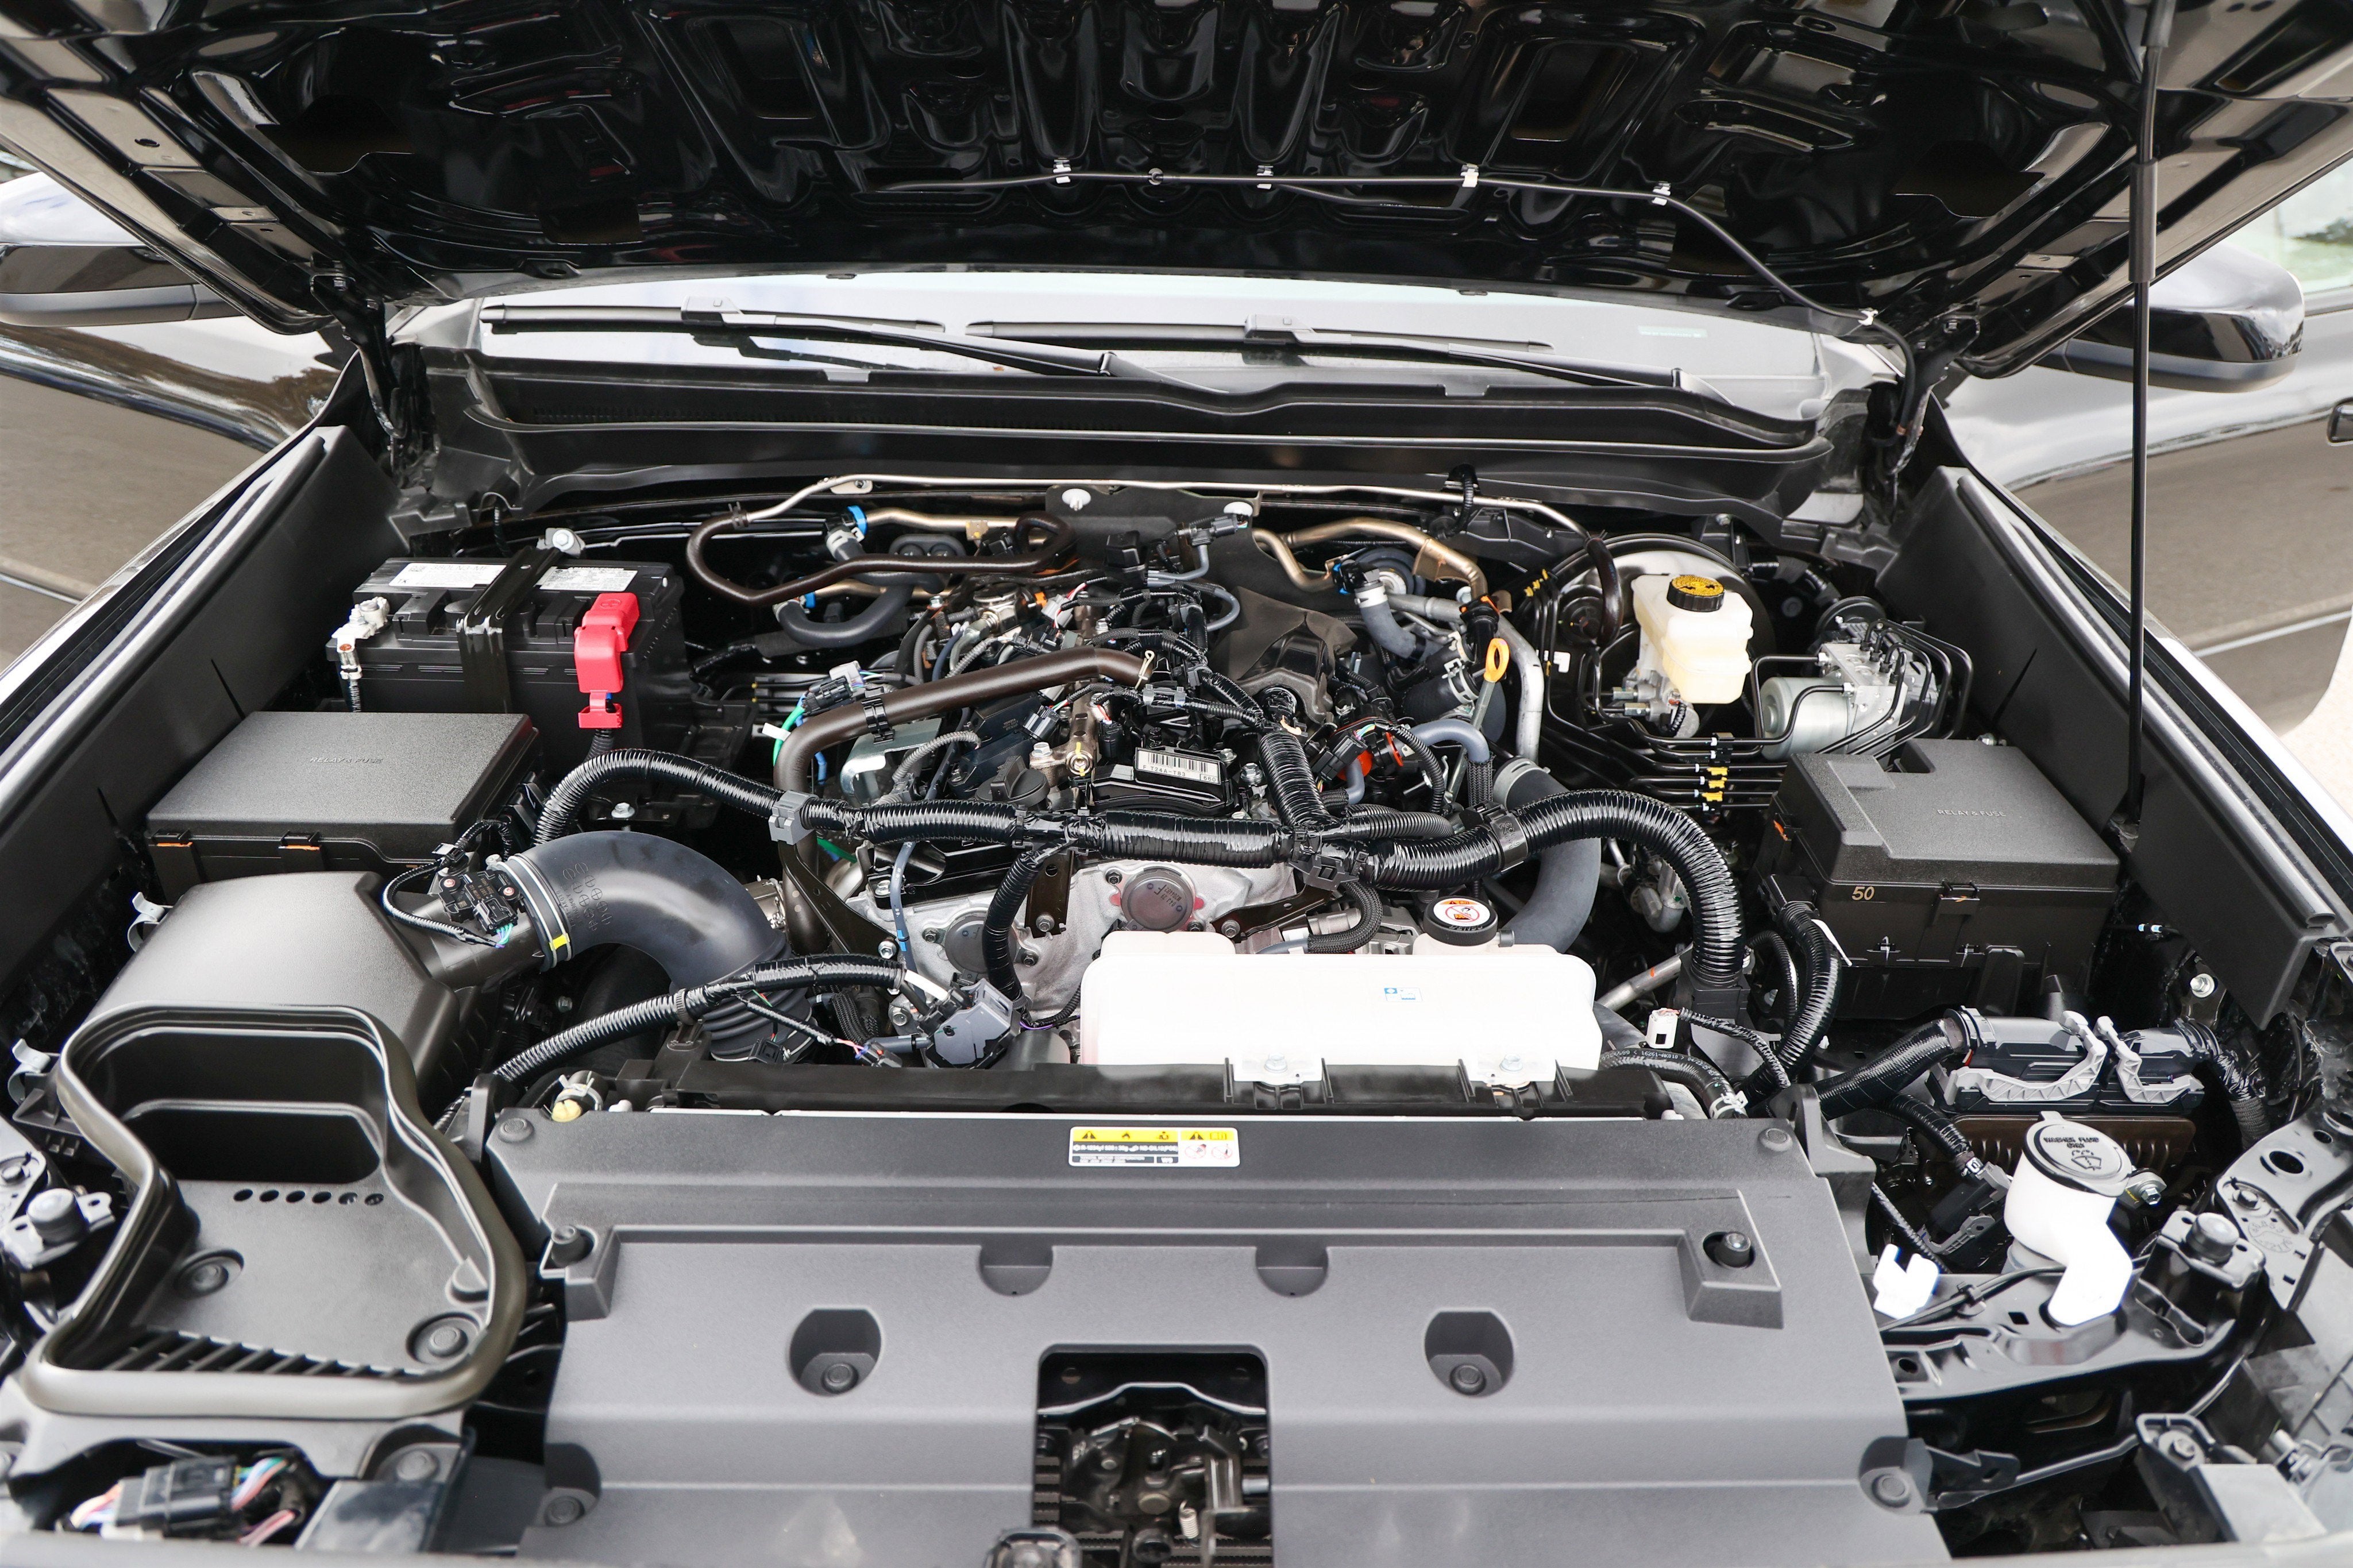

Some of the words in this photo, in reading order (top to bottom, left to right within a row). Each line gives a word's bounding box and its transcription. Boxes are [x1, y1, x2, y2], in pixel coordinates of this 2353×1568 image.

[1151, 766, 1186, 777] T24A-T83
[1851, 886, 1875, 901] 50
[1642, 1051, 1679, 1059] 16261-AK010
